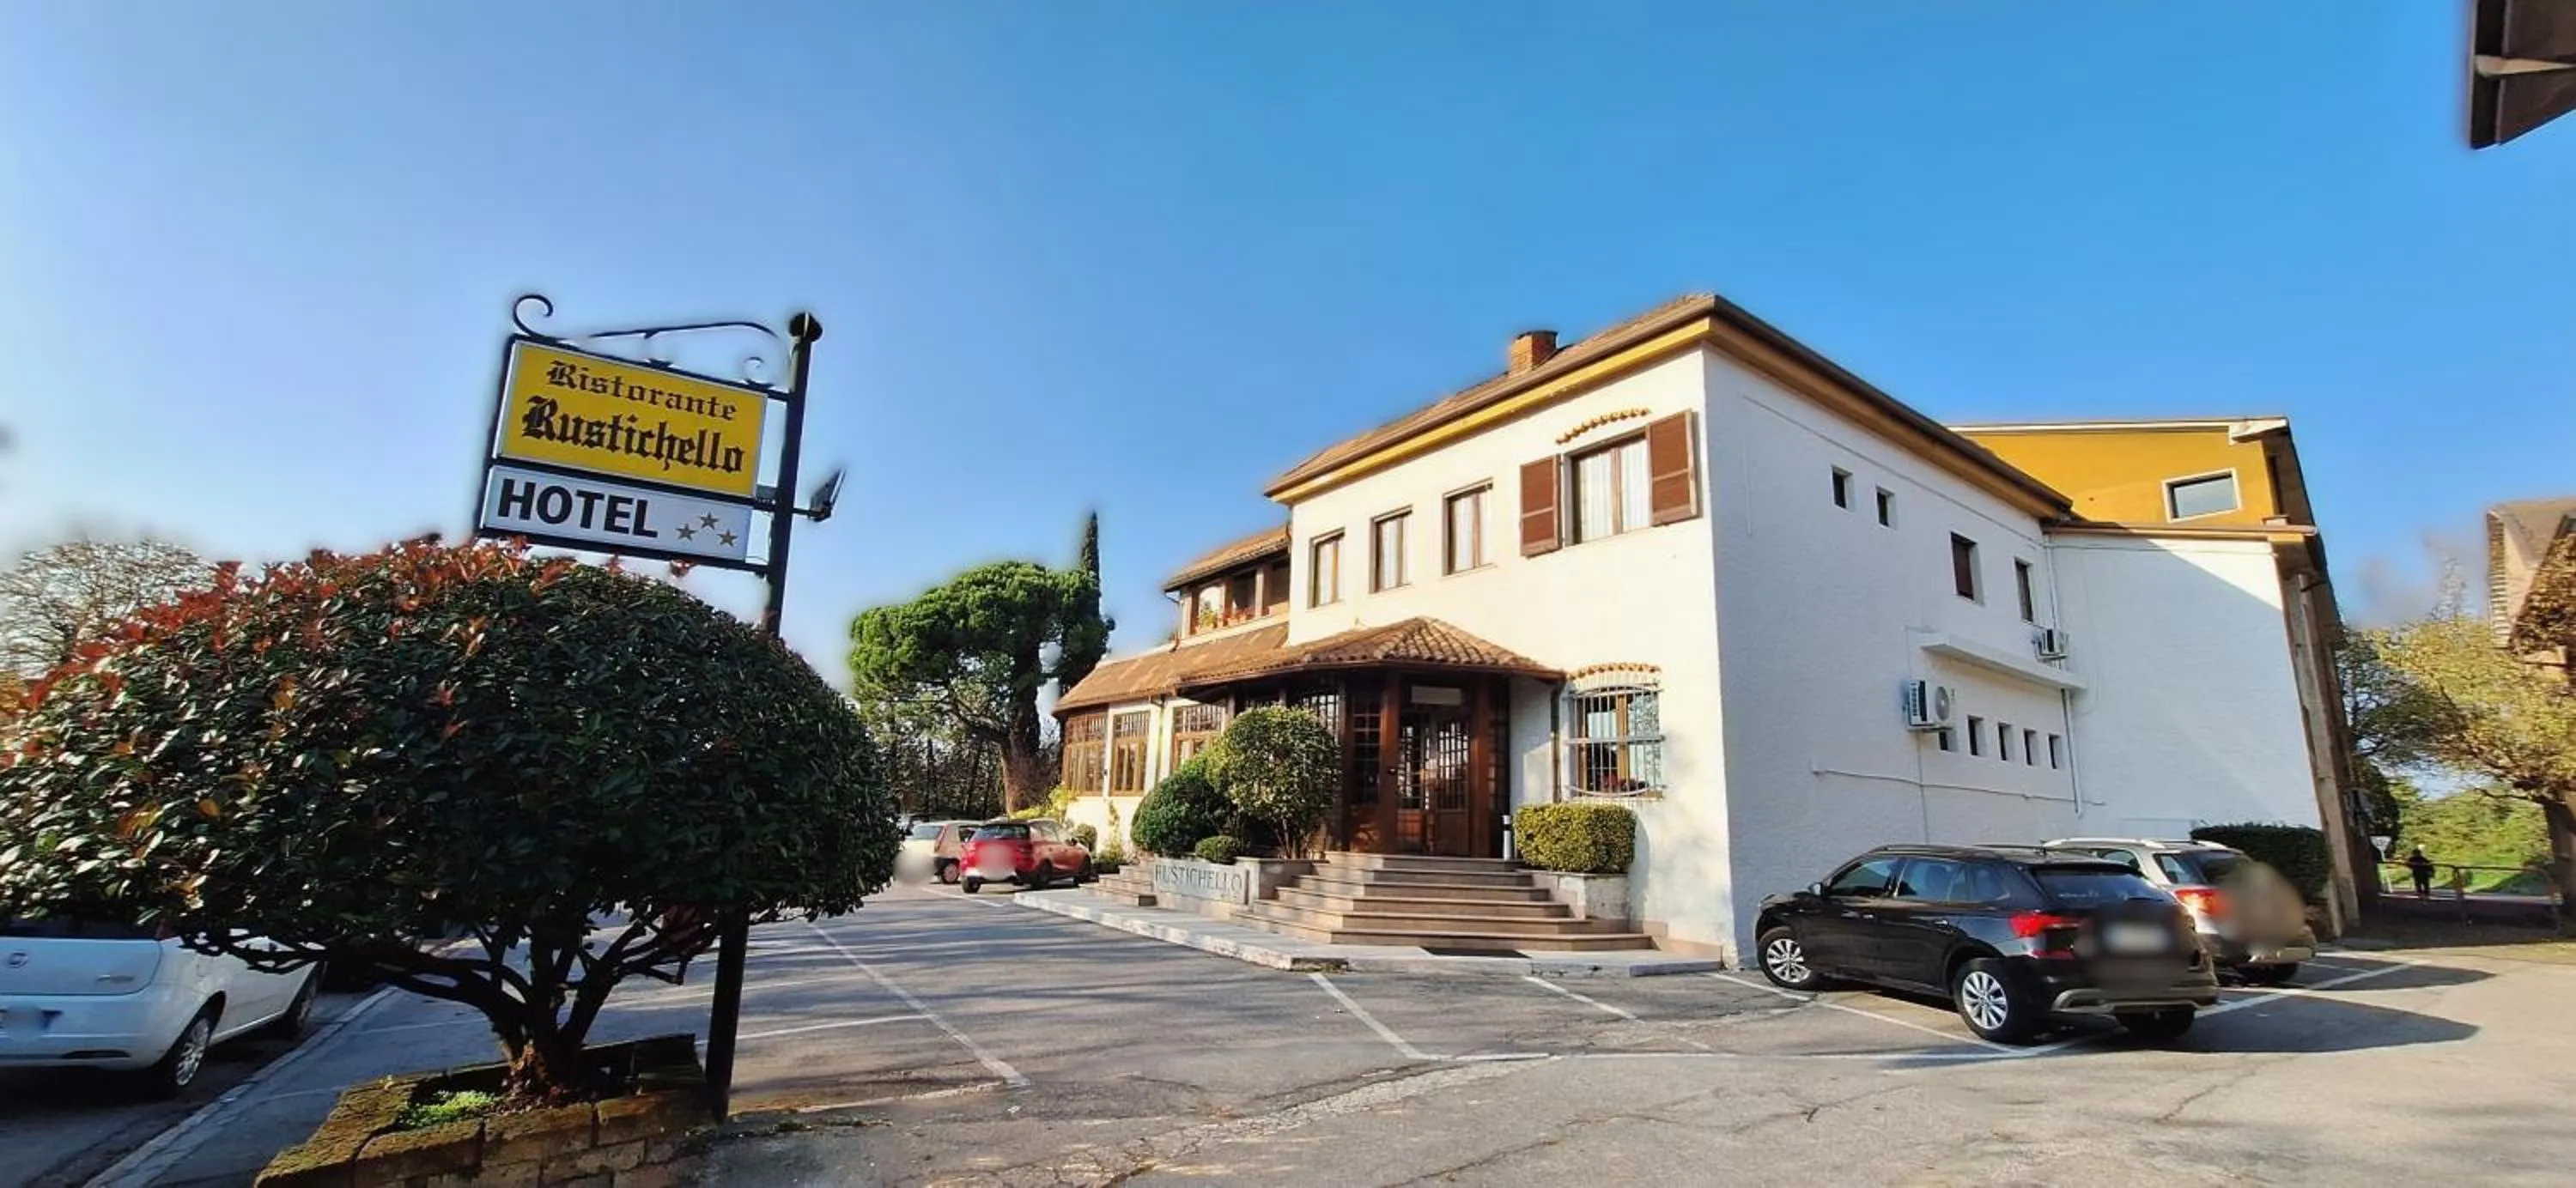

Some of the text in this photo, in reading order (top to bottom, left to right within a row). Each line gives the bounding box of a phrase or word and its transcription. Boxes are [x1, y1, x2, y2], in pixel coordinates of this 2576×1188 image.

[546, 360, 738, 421] Ristorante
[521, 395, 745, 473] Rustichello
[497, 478, 659, 538] HOTEL
